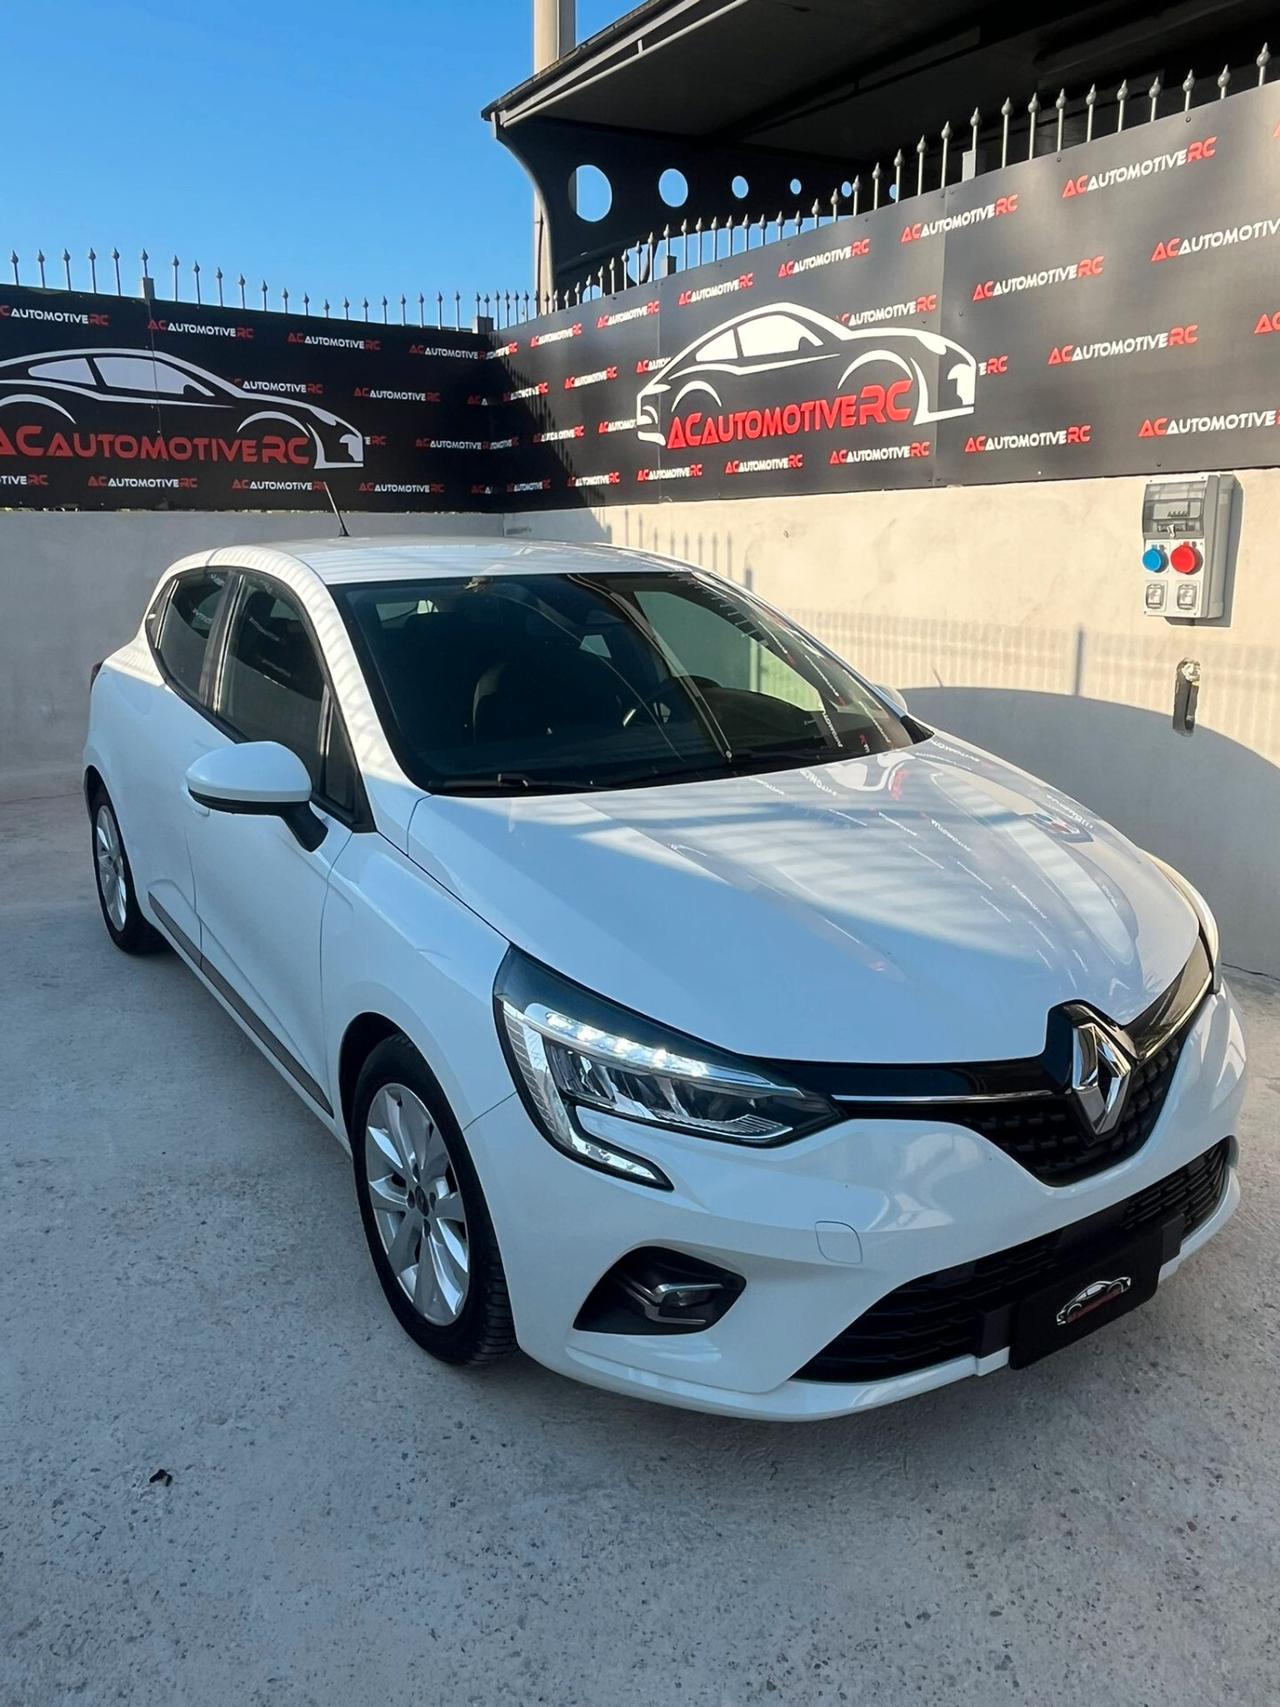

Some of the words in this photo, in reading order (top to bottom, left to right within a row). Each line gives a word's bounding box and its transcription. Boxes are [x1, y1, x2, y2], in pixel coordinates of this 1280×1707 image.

[1062, 136, 1217, 198] ACAUTOMOTIVERC
[901, 194, 1018, 243] ACAUTOMOTIVERC
[972, 256, 1104, 301] ACAUTOMOTIVERC
[1048, 325, 1198, 366] ACAUTOMOTIVERC
[667, 379, 913, 450] ACAUTOMOTIVERC
[1139, 408, 1280, 437] ACAUTOMOTIVE
[829, 441, 930, 465] ACAUTOMOTIVERC
[965, 425, 1091, 452] ACAUTOMOTIVERC
